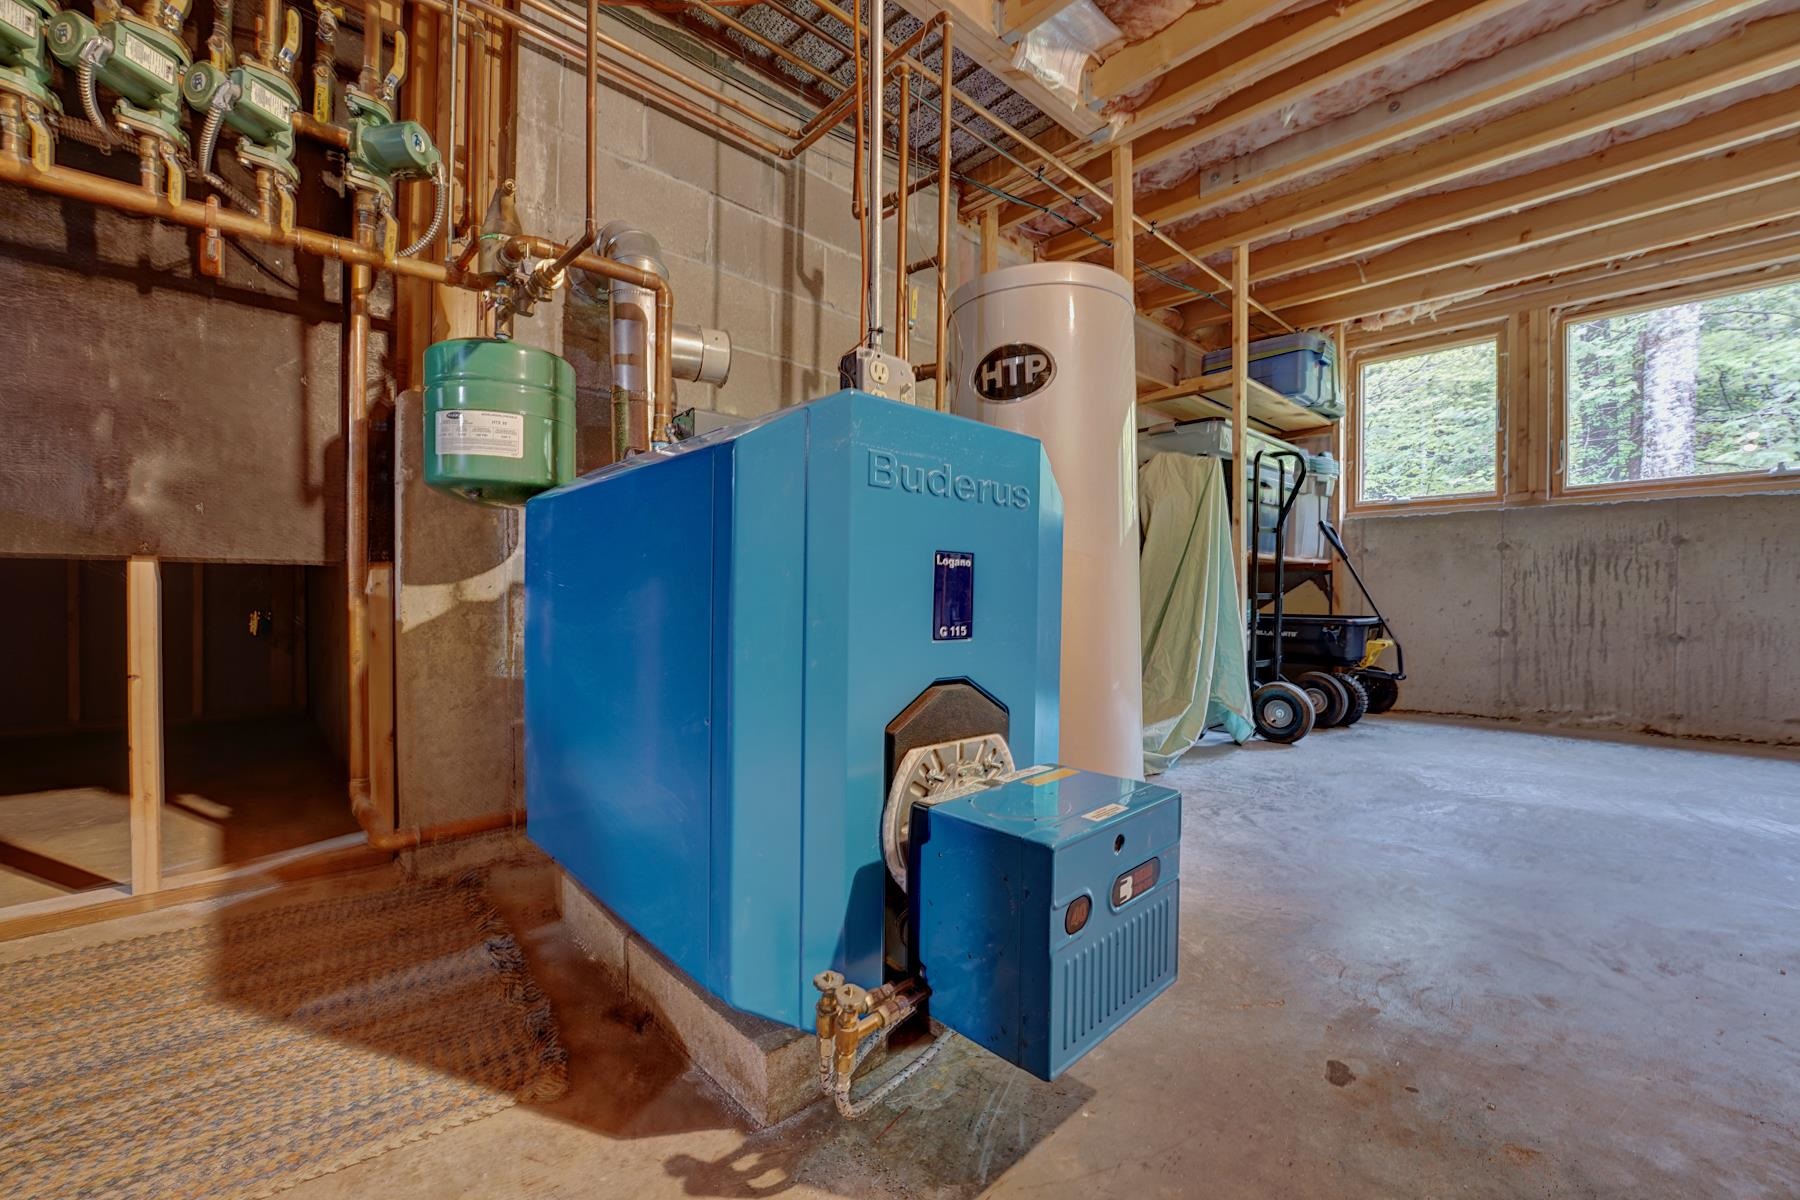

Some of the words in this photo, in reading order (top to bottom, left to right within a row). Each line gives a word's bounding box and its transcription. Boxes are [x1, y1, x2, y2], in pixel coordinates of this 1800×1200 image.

[981, 354, 1048, 392] HTP
[867, 448, 1031, 511] Buderus
[936, 554, 972, 569] Logano
[939, 626, 948, 637] G
[950, 625, 967, 637] 115
